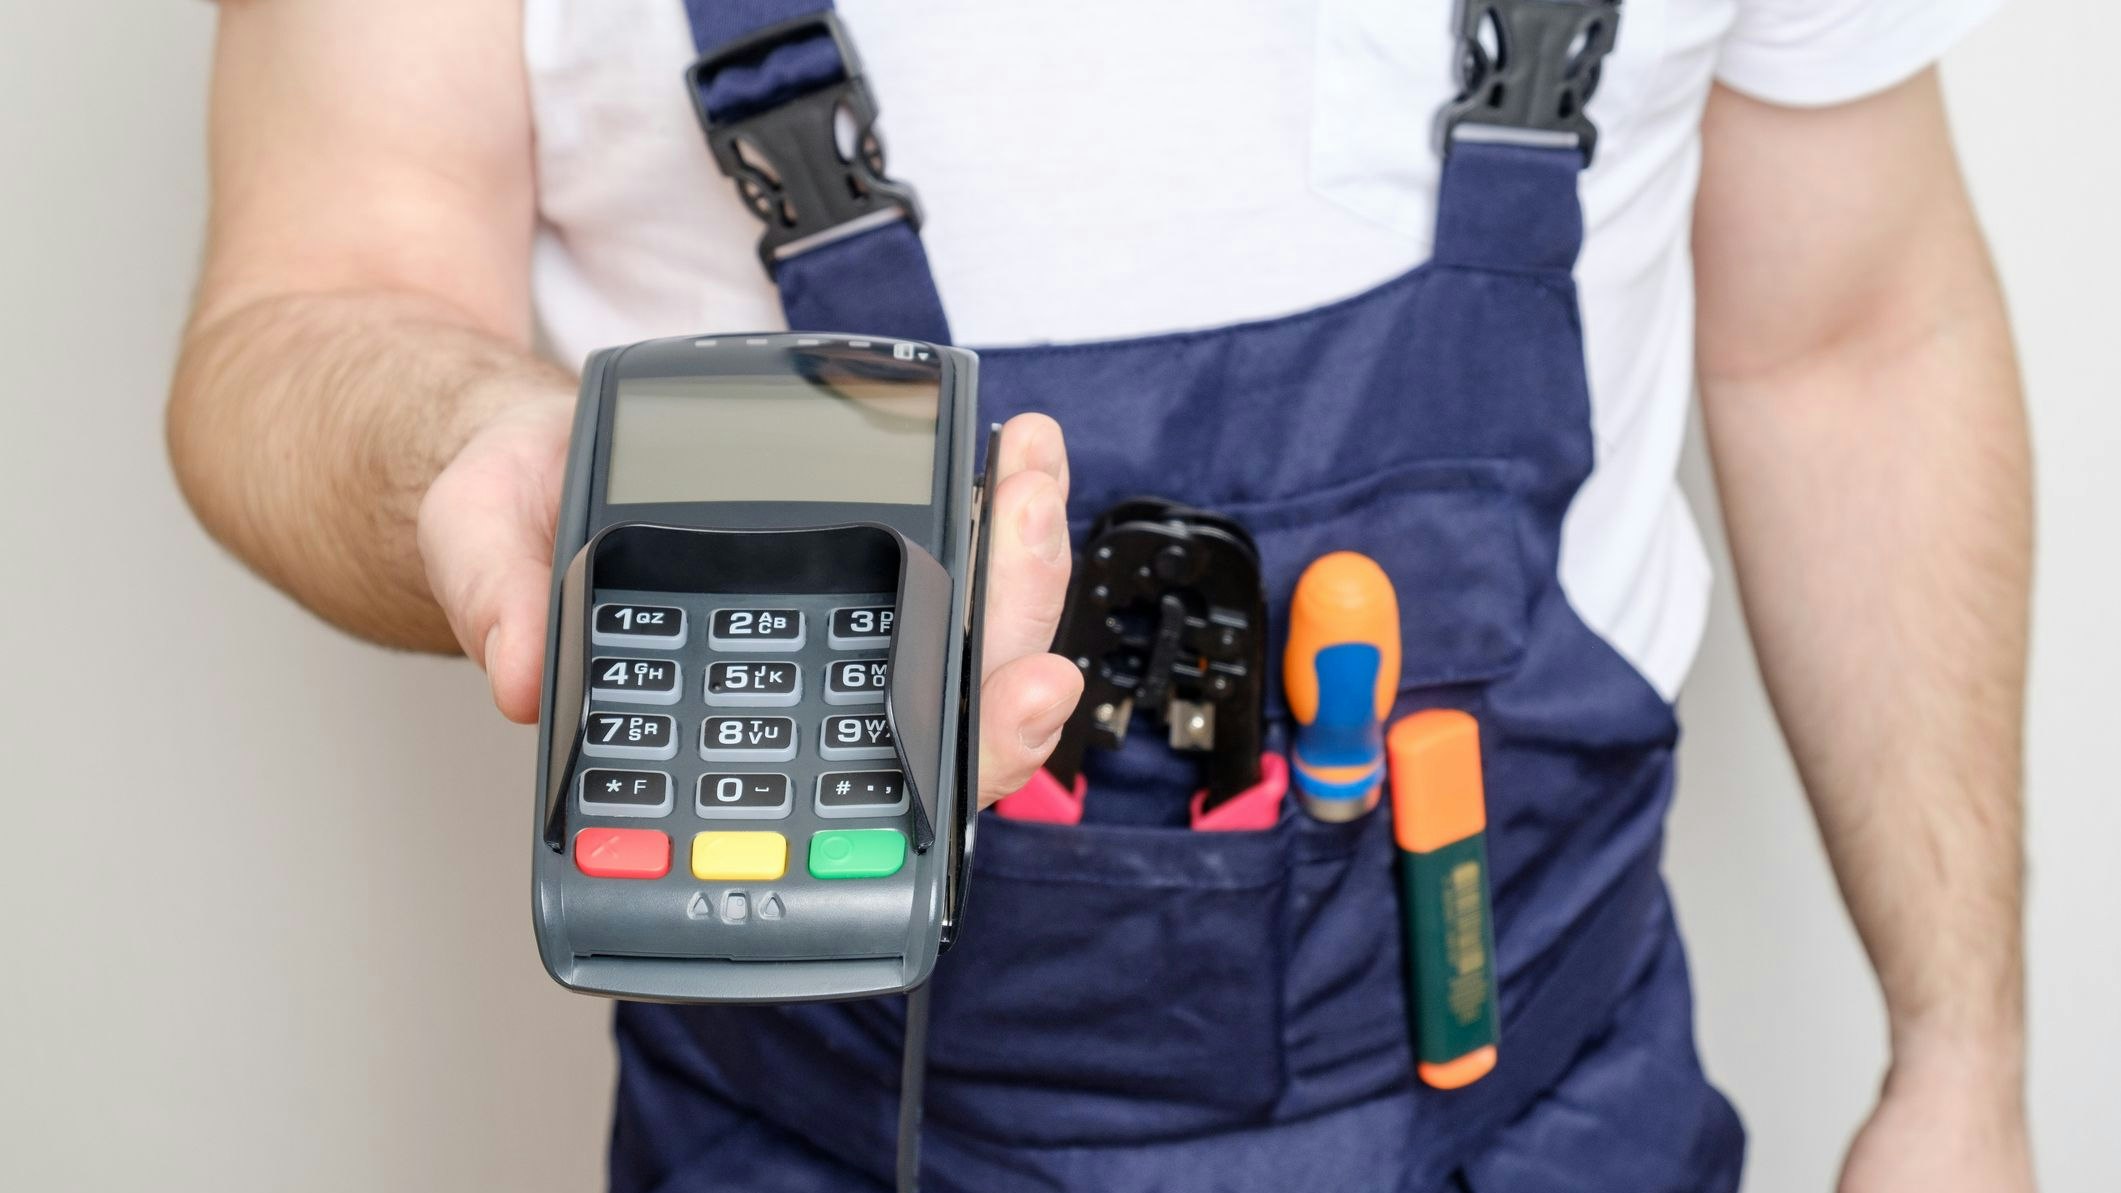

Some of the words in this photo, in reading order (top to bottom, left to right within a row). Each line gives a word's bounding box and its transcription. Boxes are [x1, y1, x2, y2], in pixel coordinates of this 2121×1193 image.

[615, 609, 632, 629] 1
[637, 613, 664, 623] QZ
[729, 613, 752, 634] 2
[851, 611, 873, 631] 3
[603, 663, 628, 684] 4
[726, 666, 748, 688] 5
[843, 665, 865, 686] 6
[600, 718, 623, 741] 7
[719, 721, 742, 744] 8
[838, 720, 861, 742] 9
[633, 779, 647, 794] F
